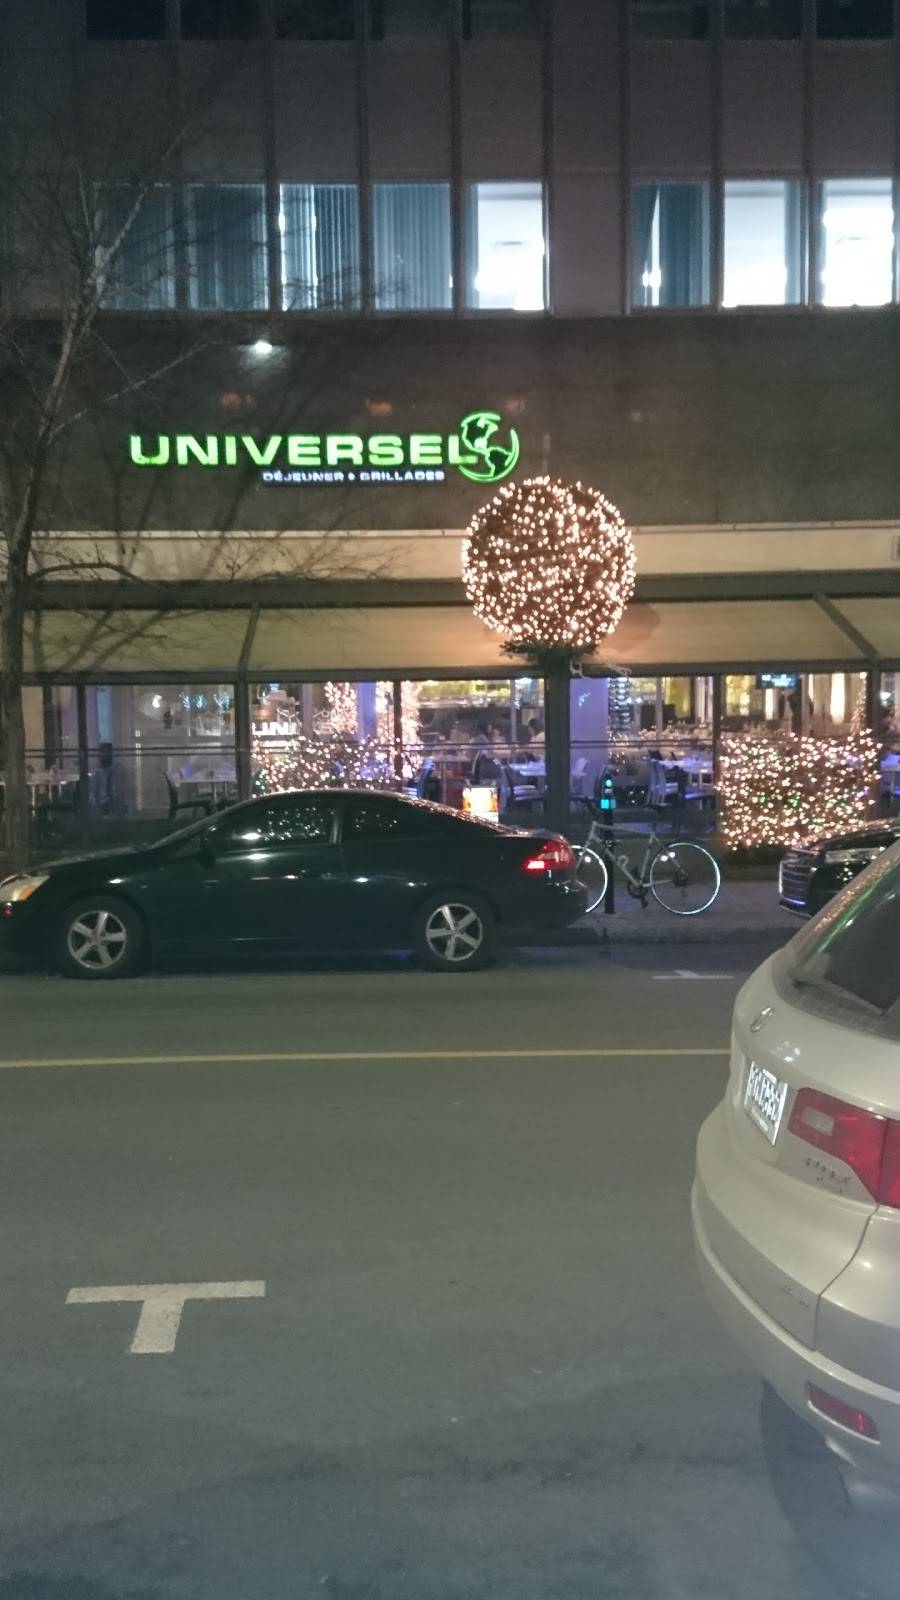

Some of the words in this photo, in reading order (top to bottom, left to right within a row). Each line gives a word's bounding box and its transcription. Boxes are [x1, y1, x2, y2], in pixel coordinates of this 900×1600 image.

[130, 434, 478, 466] UNIVERSEL
[262, 470, 345, 482] DÉJEUNER
[359, 470, 446, 482] GRILLADES
